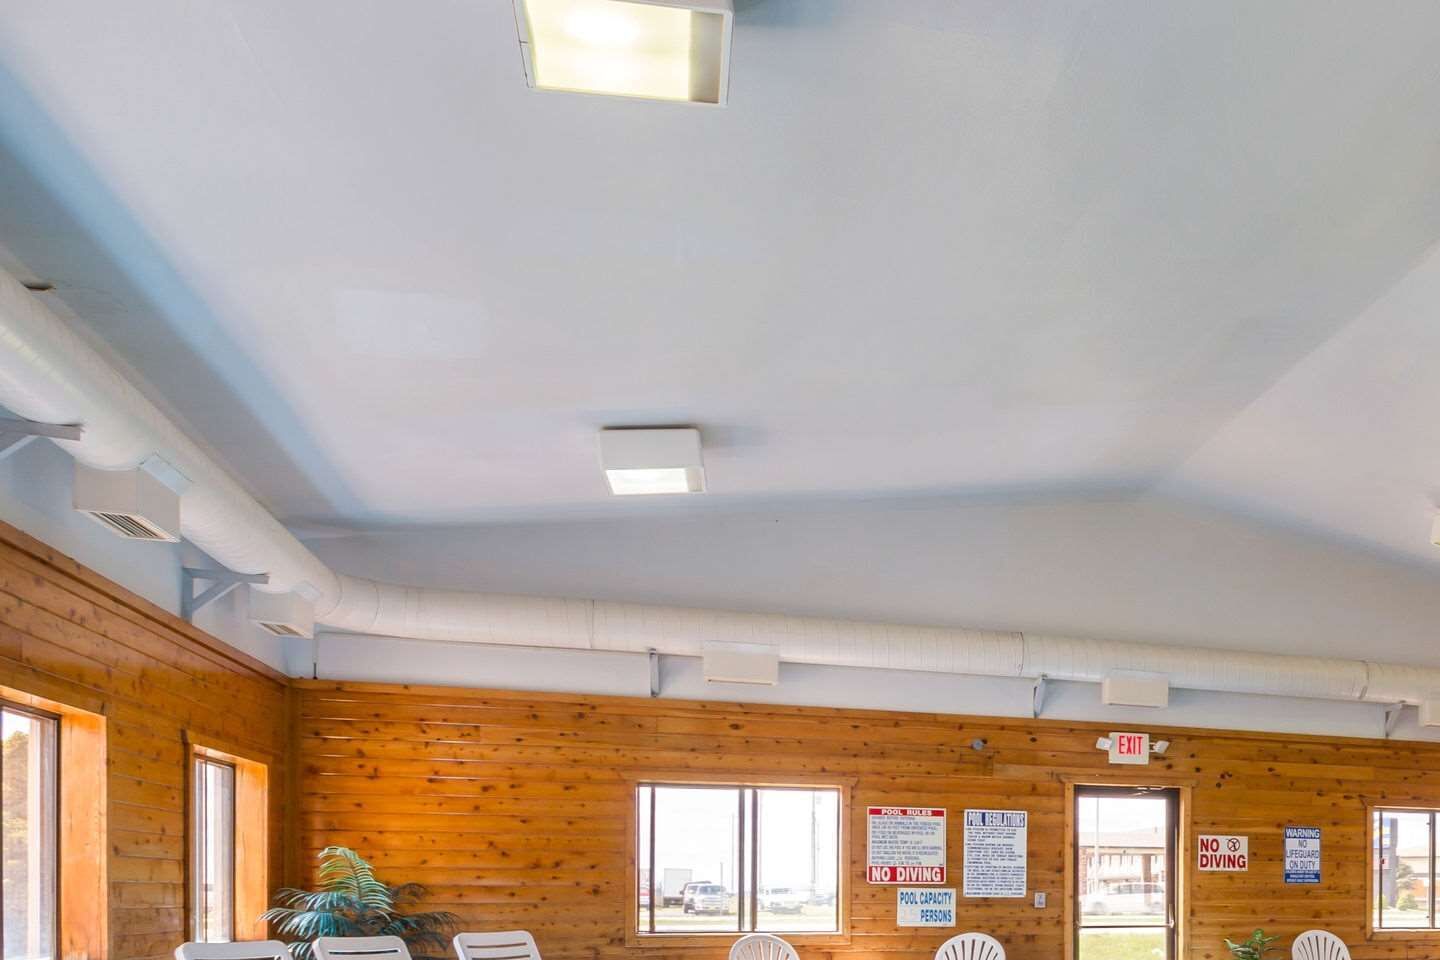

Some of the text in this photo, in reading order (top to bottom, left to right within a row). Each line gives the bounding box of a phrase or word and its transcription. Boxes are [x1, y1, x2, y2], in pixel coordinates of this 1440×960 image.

[1118, 735, 1144, 755] EXIT
[881, 808, 903, 816] POOL
[968, 812, 1025, 827] POOL REGULATIONS
[1285, 828, 1320, 838] WARNING
[1200, 838, 1220, 852] NO
[1298, 840, 1307, 849] NO
[1286, 849, 1320, 858] LIFEGUARD
[1200, 854, 1247, 868] DIVING
[1289, 860, 1316, 870] ON DUTY
[872, 866, 942, 882] NO DIVING
[900, 891, 953, 905] POOL CAPACITY
[920, 909, 952, 922] PERSONS
